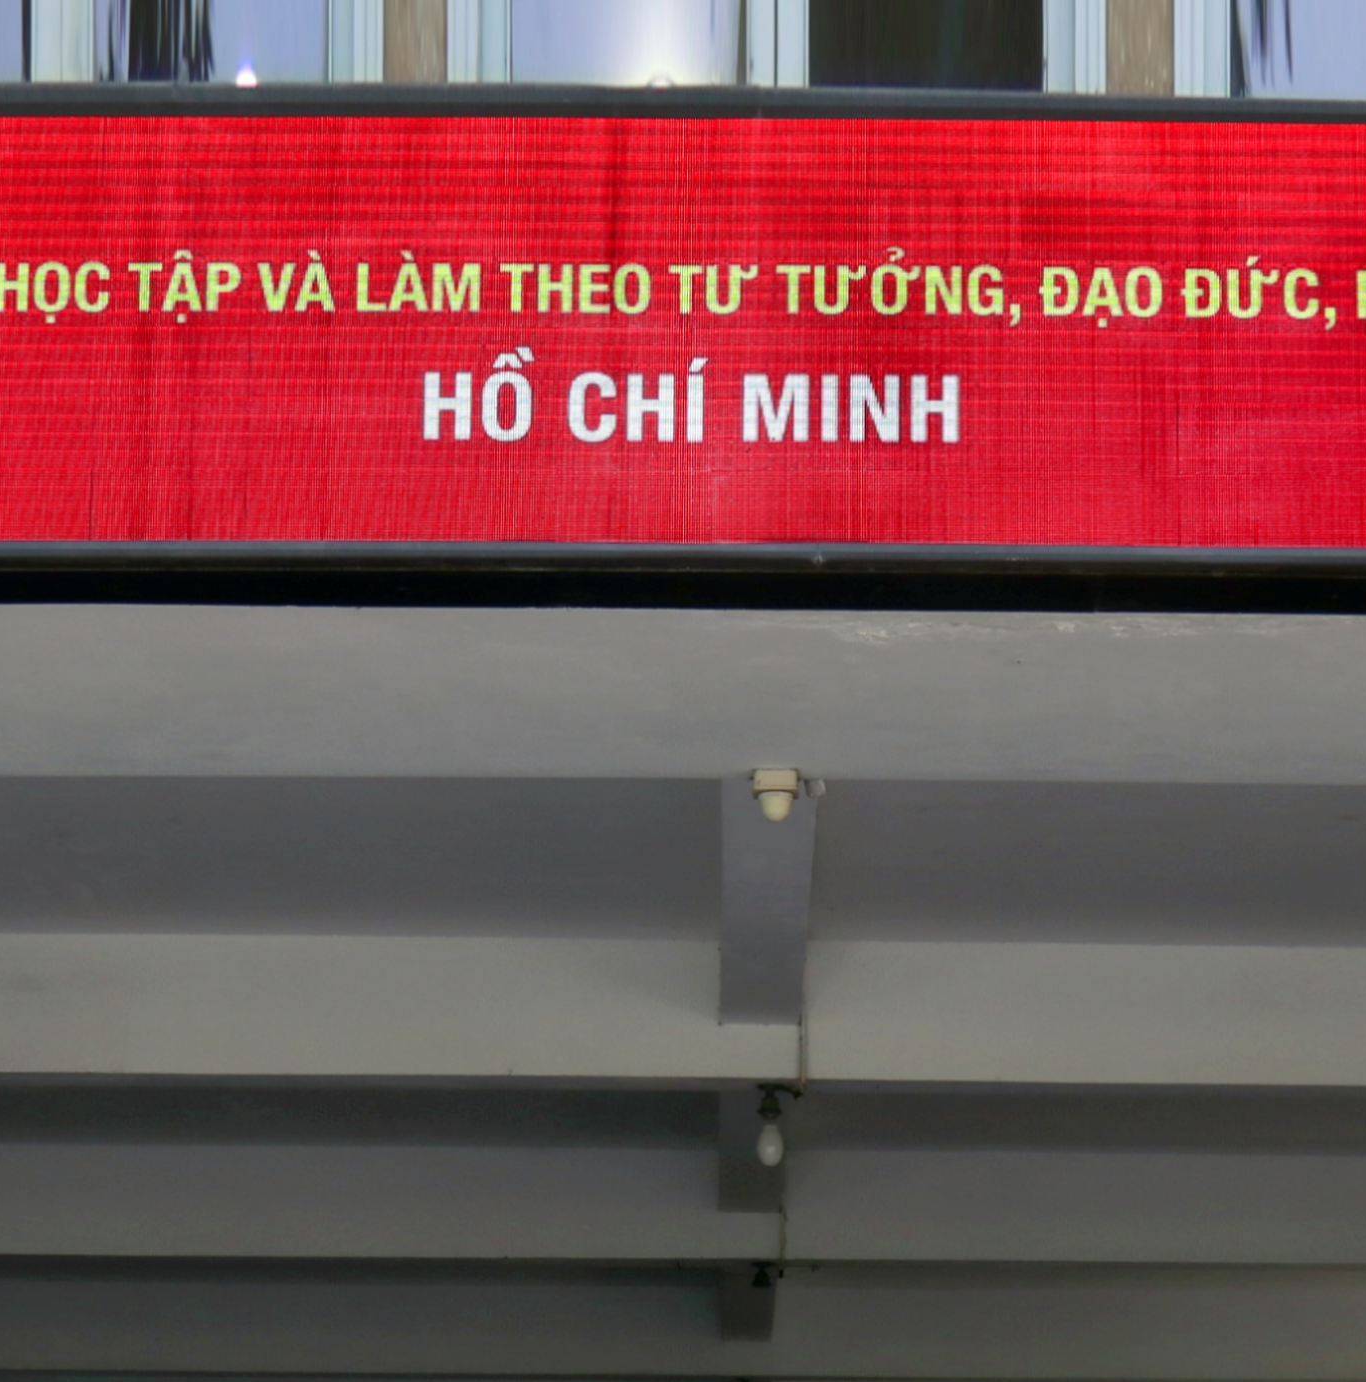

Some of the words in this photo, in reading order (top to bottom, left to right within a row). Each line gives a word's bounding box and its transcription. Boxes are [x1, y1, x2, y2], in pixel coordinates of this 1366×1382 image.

[128, 250, 241, 322] TẬP
[258, 251, 335, 312] VÀ
[357, 251, 480, 313] LÀM
[500, 264, 650, 314] THEO
[669, 264, 758, 314] TƯ
[776, 247, 1021, 327] TƯỞNG,
[1039, 267, 1163, 328] ĐẠO
[1181, 255, 1337, 329] ĐỨC,
[423, 346, 535, 441] HỒ
[567, 357, 707, 443] CHÍ
[742, 373, 960, 443] MINH
